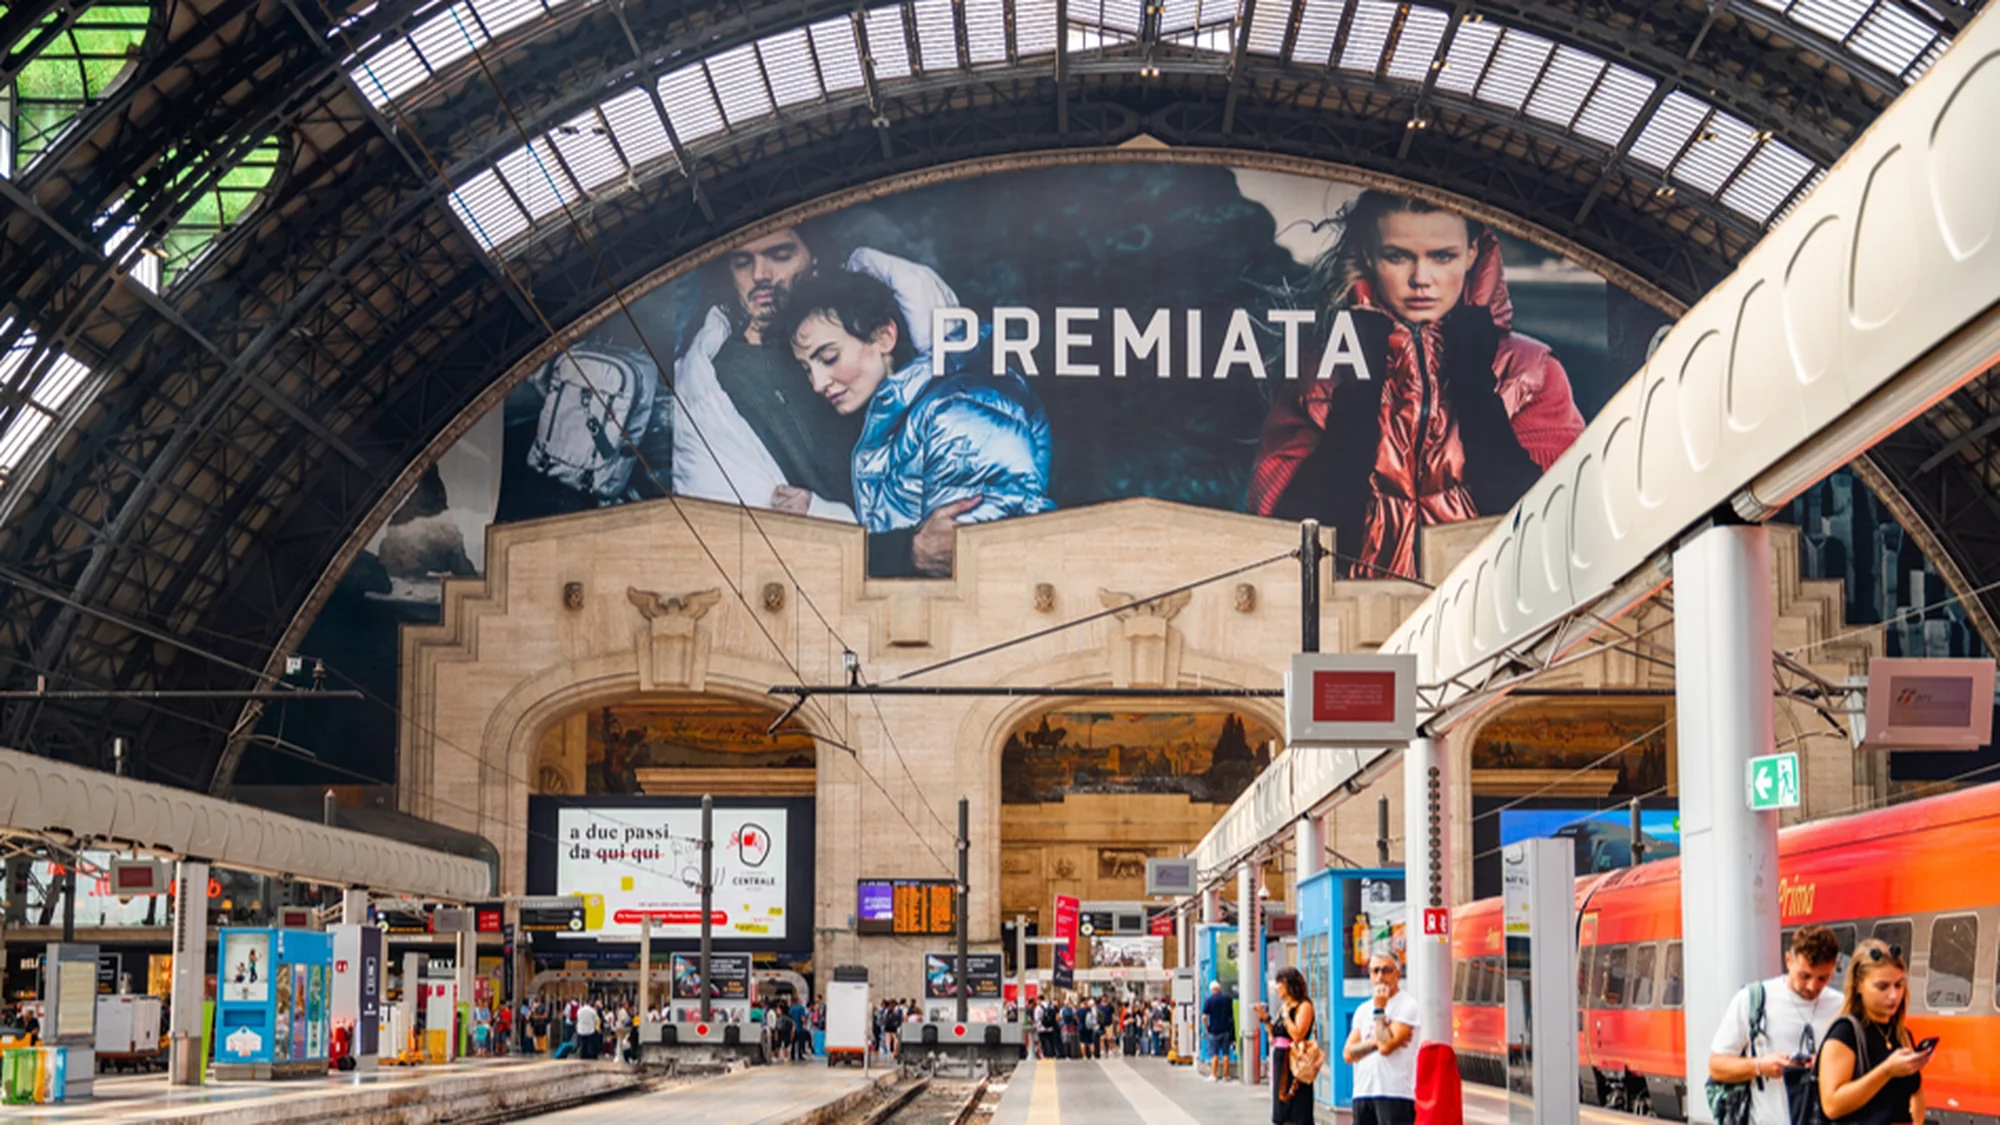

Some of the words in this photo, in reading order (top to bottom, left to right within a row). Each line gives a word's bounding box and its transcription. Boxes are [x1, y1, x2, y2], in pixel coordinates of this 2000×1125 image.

[932, 307, 1370, 379] PREMIATA
[570, 827, 579, 839] a
[586, 823, 618, 839] due
[625, 823, 669, 843] passi
[569, 844, 590, 859] da
[595, 844, 625, 863] qui
[631, 844, 660, 863] qui
[732, 876, 775, 886] CENTRALE
